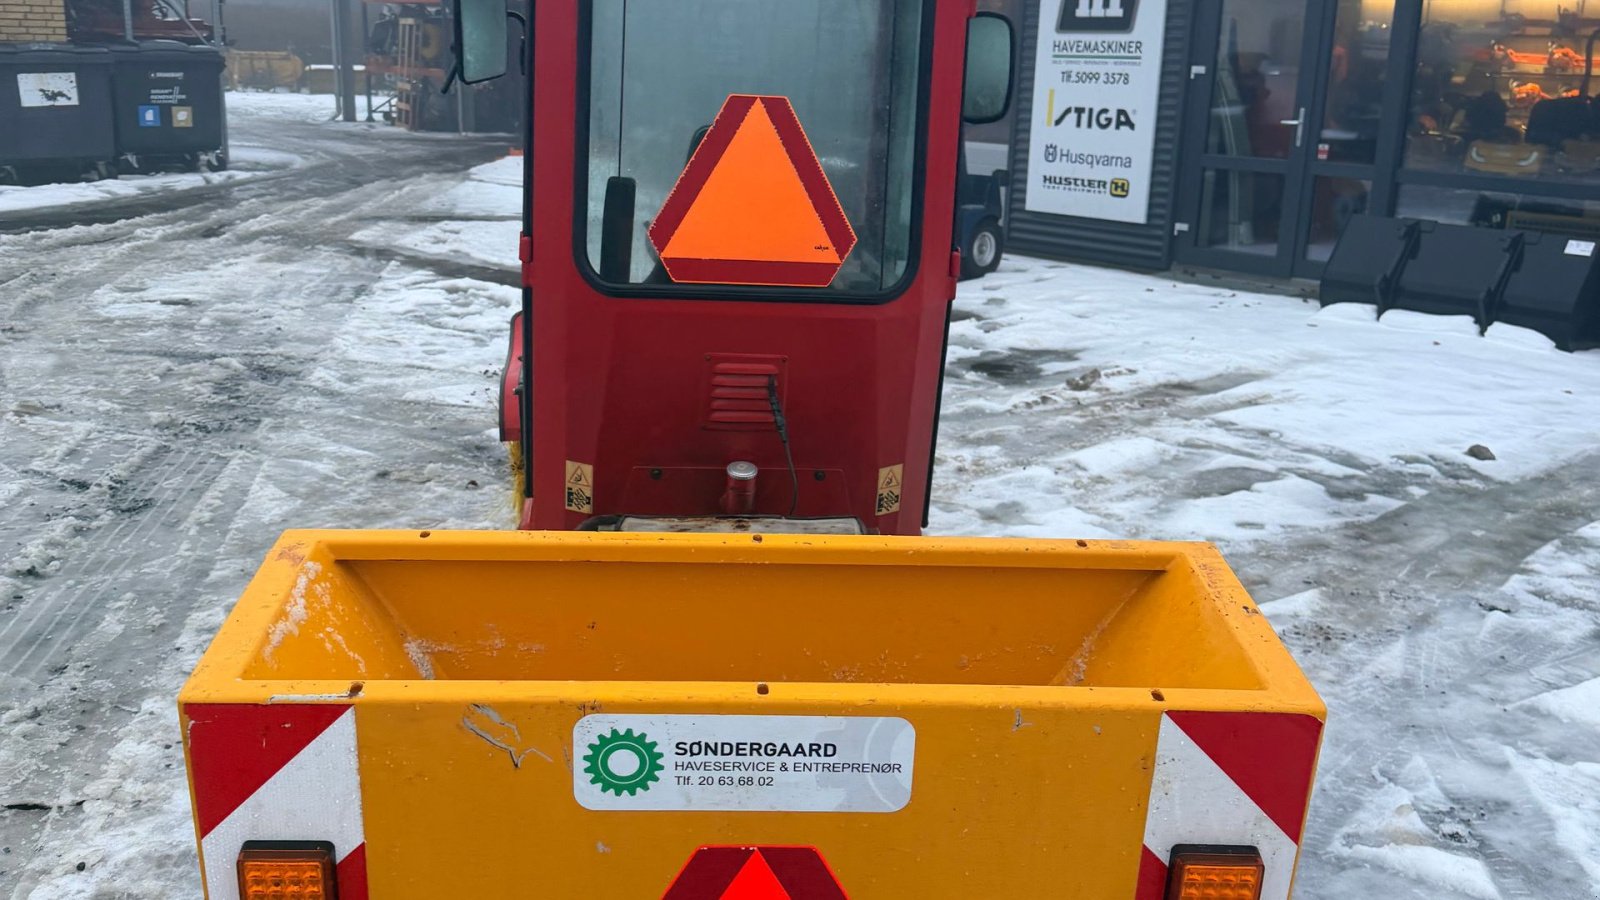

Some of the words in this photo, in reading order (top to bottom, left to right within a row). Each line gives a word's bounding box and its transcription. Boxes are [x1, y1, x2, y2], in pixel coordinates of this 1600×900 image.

[1053, 40, 1142, 54] HAVEMASKINER
[1103, 72, 1130, 85] 3578
[1059, 148, 1132, 168] Husqvarna
[1042, 174, 1108, 190] HUSTLER
[674, 741, 837, 757] SØNDERGAARD
[674, 761, 776, 772] HAVESERVICE
[779, 762, 789, 772] &
[793, 762, 902, 773] ENTREPRENØR
[674, 775, 694, 786] Tlf.
[698, 776, 714, 786] 20
[717, 776, 734, 786] 63
[737, 776, 754, 787] 68
[757, 776, 774, 787] 02
